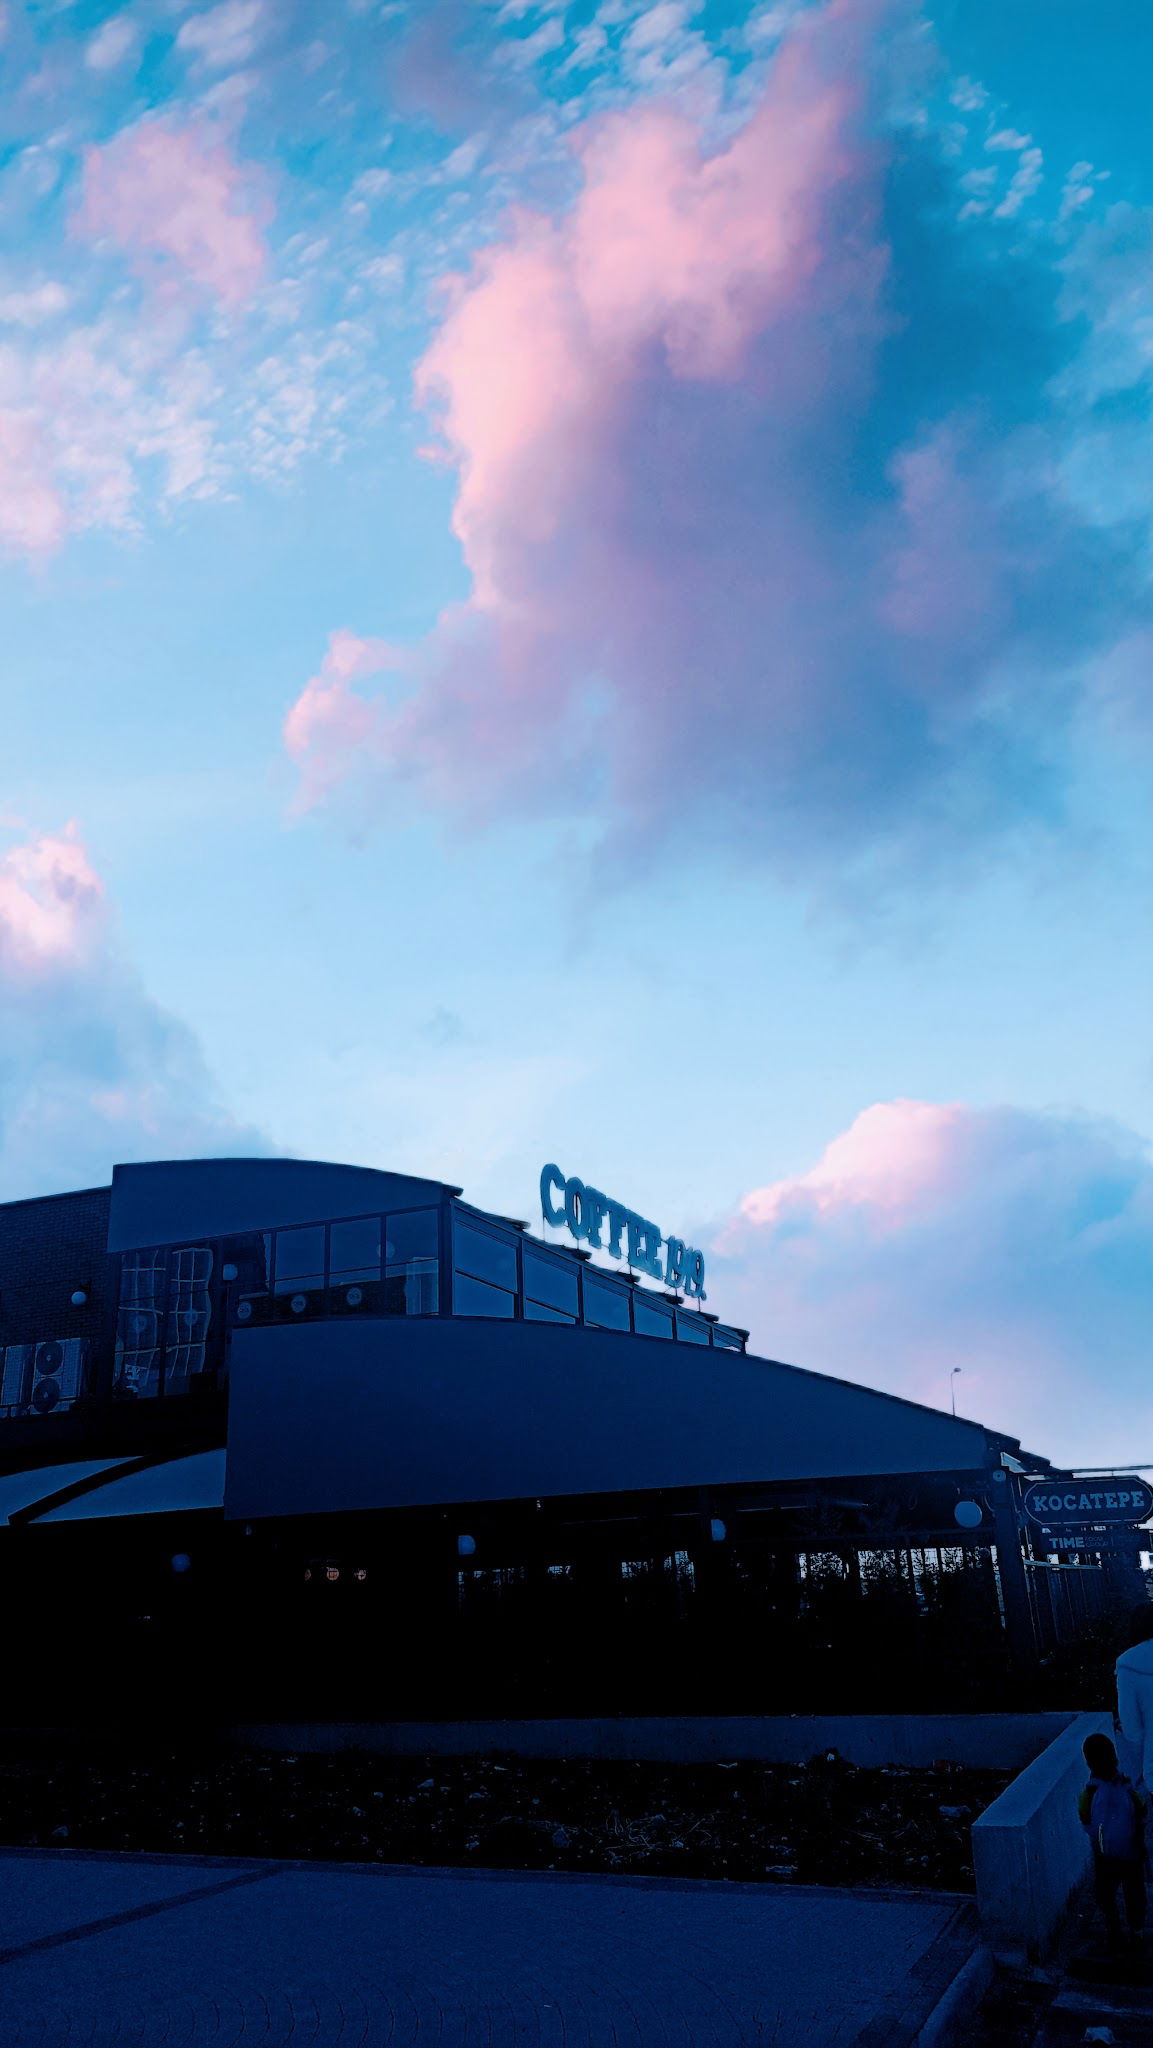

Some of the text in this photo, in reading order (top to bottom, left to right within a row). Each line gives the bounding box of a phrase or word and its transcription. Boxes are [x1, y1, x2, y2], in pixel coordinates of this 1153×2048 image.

[540, 1163, 663, 1281] COFFEE
[1032, 1491, 1145, 1512] KOCATEPE
[1049, 1537, 1086, 1549] TIME
